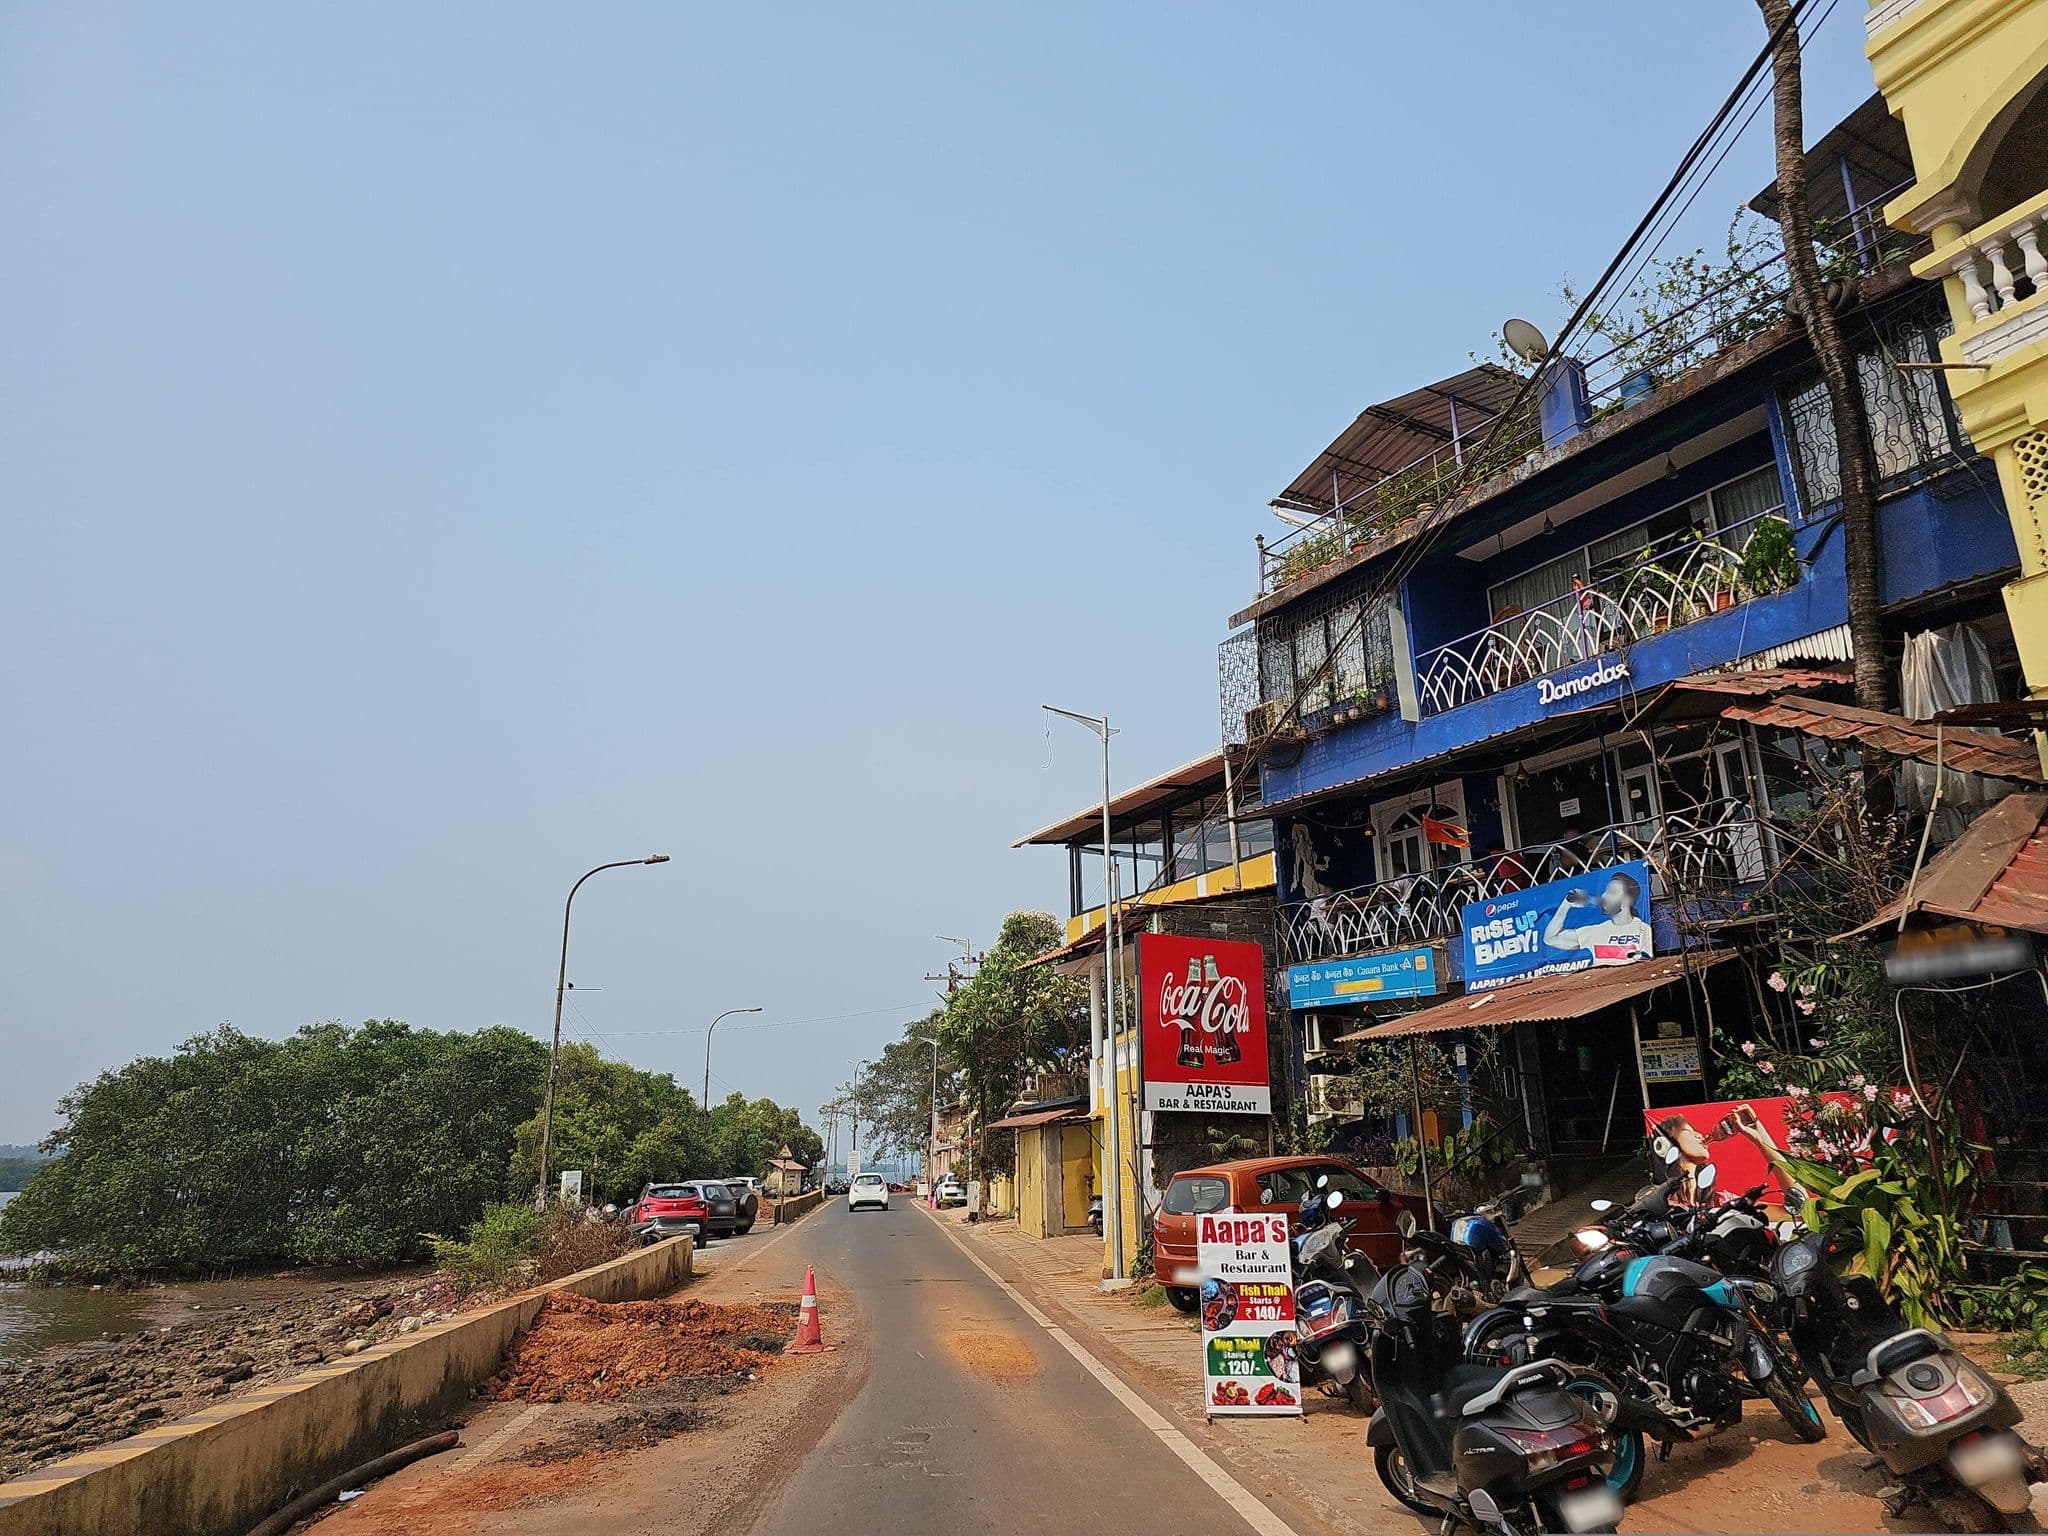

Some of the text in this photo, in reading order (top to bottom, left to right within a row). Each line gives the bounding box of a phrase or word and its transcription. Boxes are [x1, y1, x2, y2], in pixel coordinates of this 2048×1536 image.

[1537, 659, 1630, 705] Damodar
[1497, 900, 1520, 914] pepsi
[1471, 910, 1538, 944] RISE UP
[1475, 929, 1539, 965] BABY!
[1357, 966, 1381, 976] Canara
[1381, 962, 1399, 973] Bank
[1469, 976, 1505, 991] AAPA'S
[1160, 972, 1250, 1034] Coca-Cola
[1183, 1044, 1203, 1054] Real
[1186, 1084, 1232, 1098] AAPA'S
[1159, 1098, 1257, 1111] BAR & RESTAURANT
[1202, 1216, 1287, 1246] Aapa's
[1235, 1249, 1270, 1260] Bar &
[1221, 1263, 1287, 1273] Restaurant
[1240, 1284, 1288, 1297] Fish Thali
[1249, 1297, 1281, 1305] Starts @
[1254, 1306, 1287, 1320] 140/-
[1235, 1339, 1260, 1350] Thali
[1228, 1360, 1261, 1375] 120/-
[1518, 1373, 1544, 1385] HONDA
